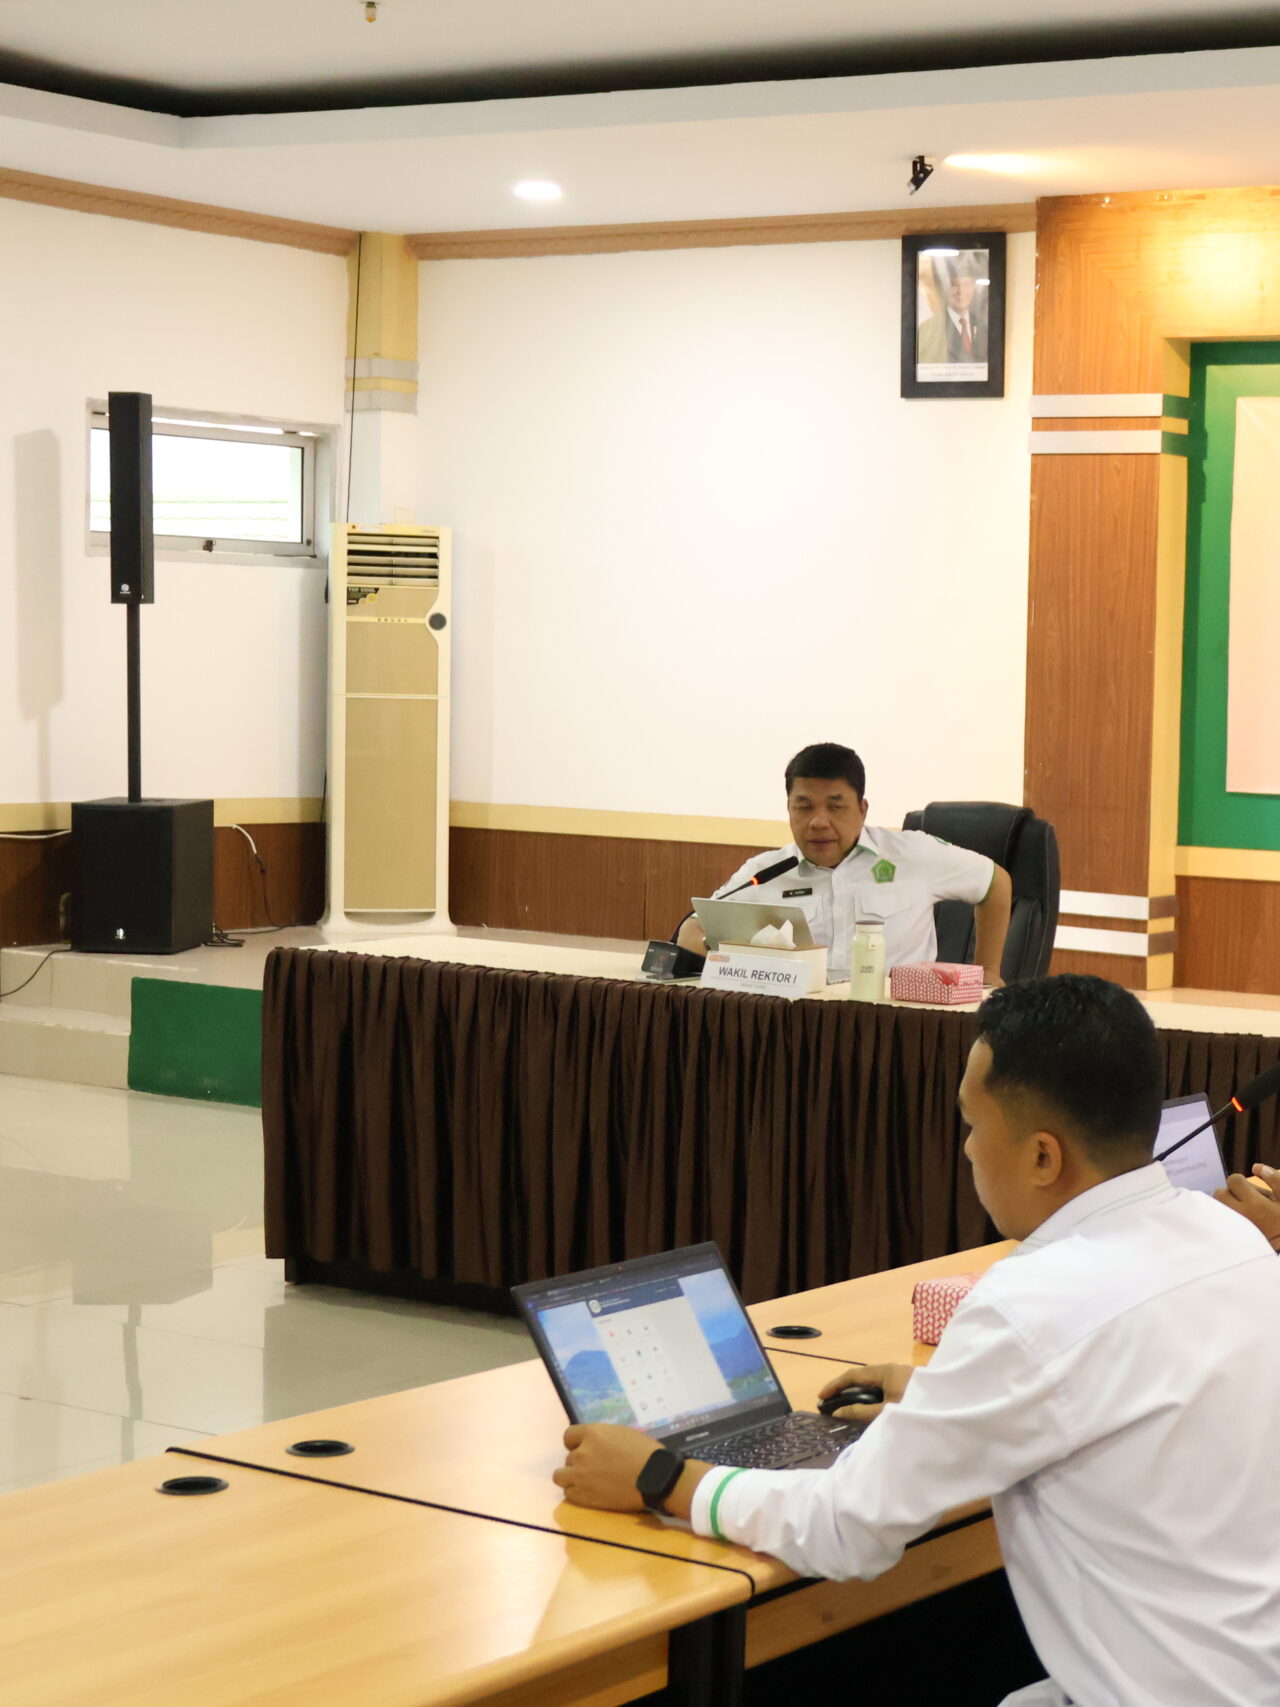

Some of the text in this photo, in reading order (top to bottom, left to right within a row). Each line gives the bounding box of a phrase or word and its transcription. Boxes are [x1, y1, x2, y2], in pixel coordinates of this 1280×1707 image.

[718, 966, 798, 984] WAKIL REKTOR I
